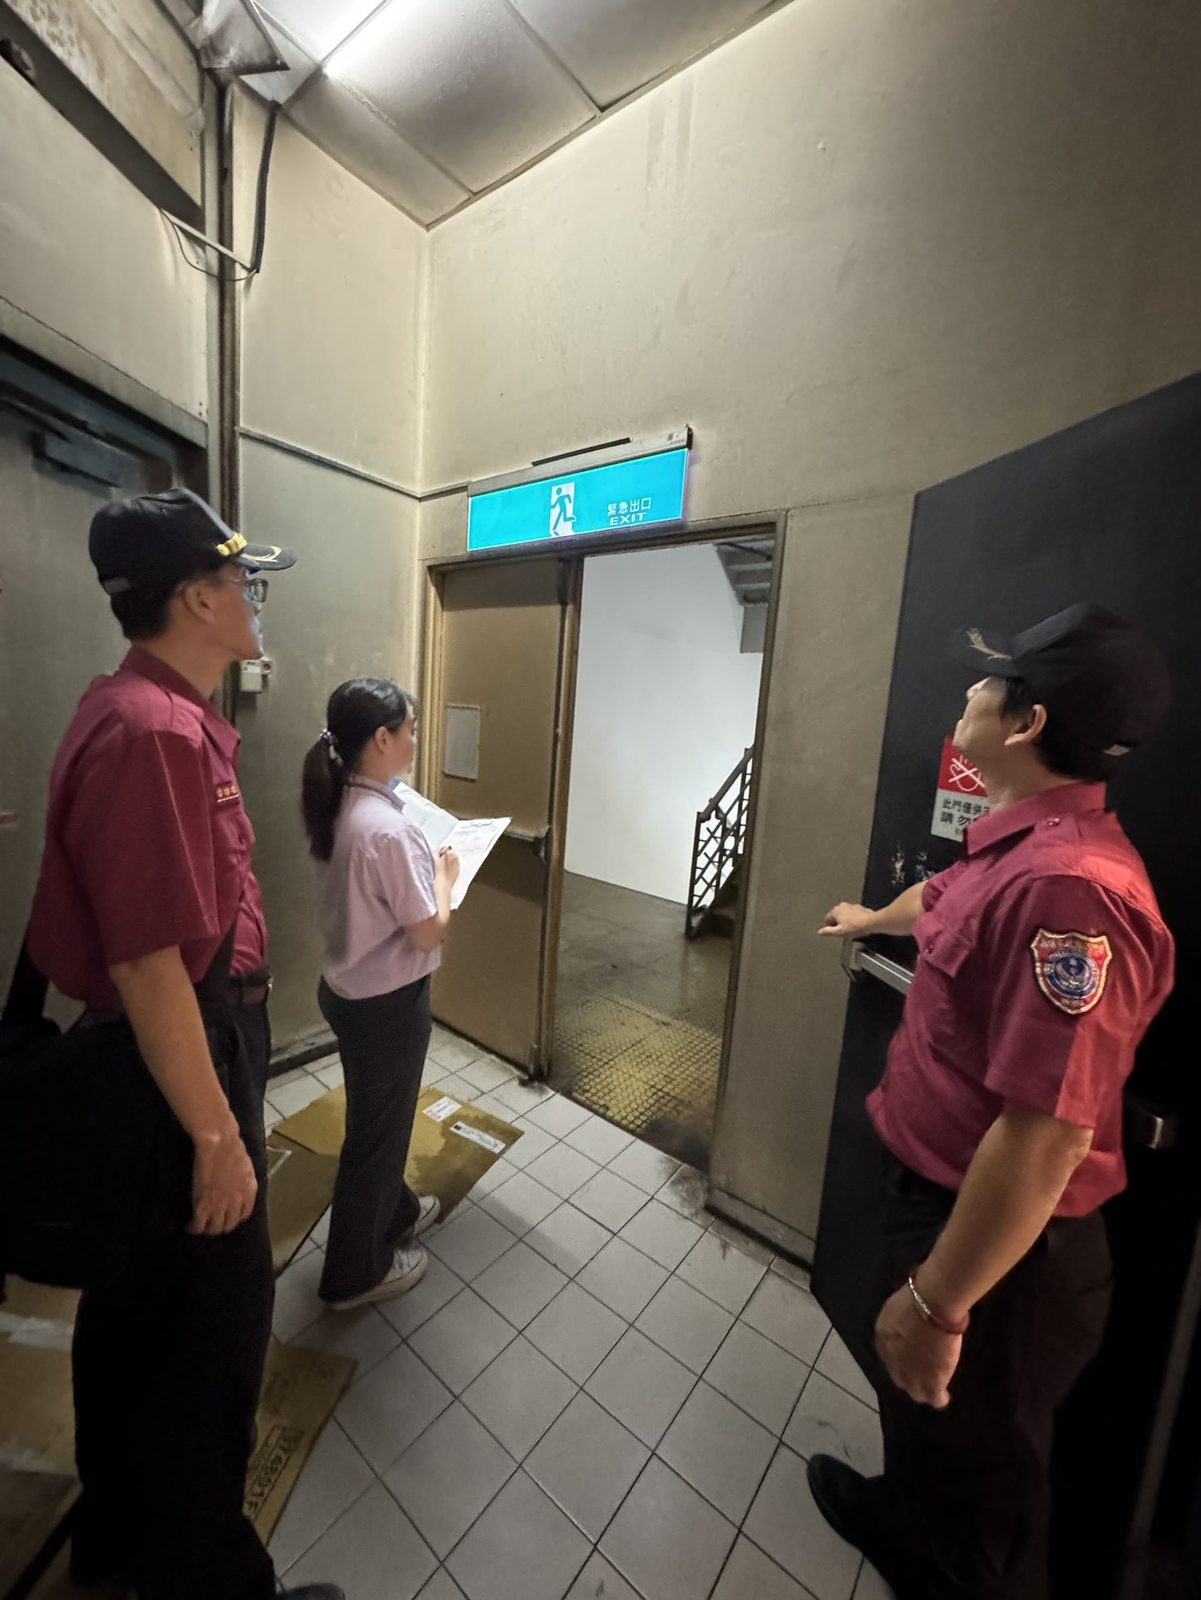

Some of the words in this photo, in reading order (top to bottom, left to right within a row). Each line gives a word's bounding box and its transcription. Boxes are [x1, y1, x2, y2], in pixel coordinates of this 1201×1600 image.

[608, 497, 652, 516] 緊急出口
[609, 511, 647, 526] EXIT
